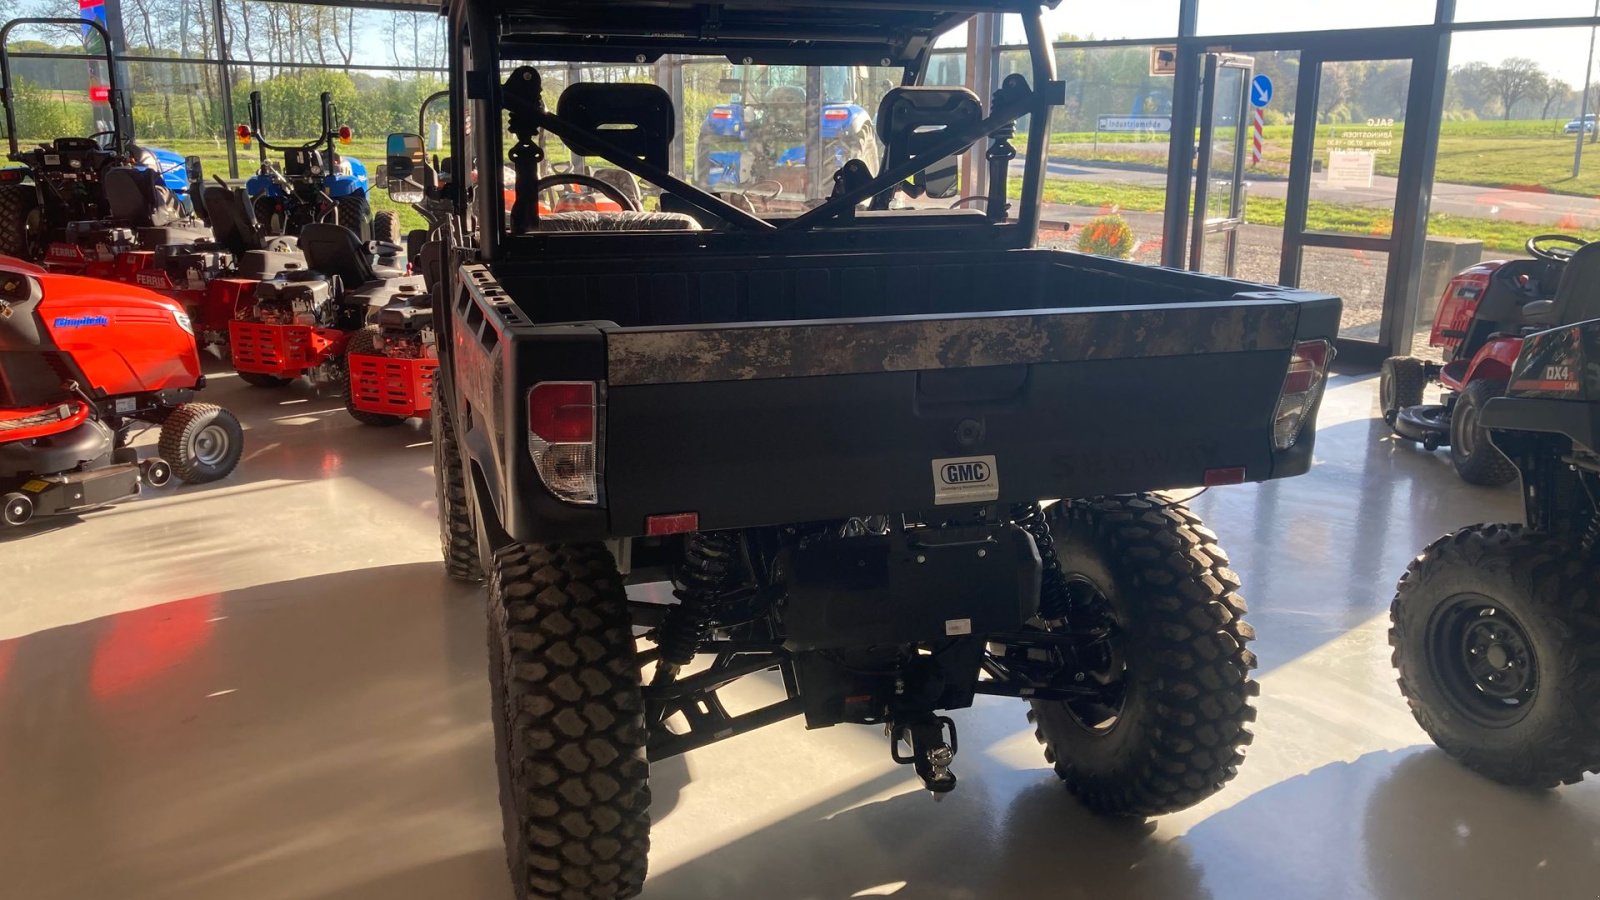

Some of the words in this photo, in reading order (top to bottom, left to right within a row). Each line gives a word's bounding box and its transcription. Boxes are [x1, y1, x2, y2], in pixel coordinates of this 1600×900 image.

[51, 247, 77, 258] FERRIS
[136, 274, 166, 287] FERRIS
[947, 463, 984, 482] GMC
